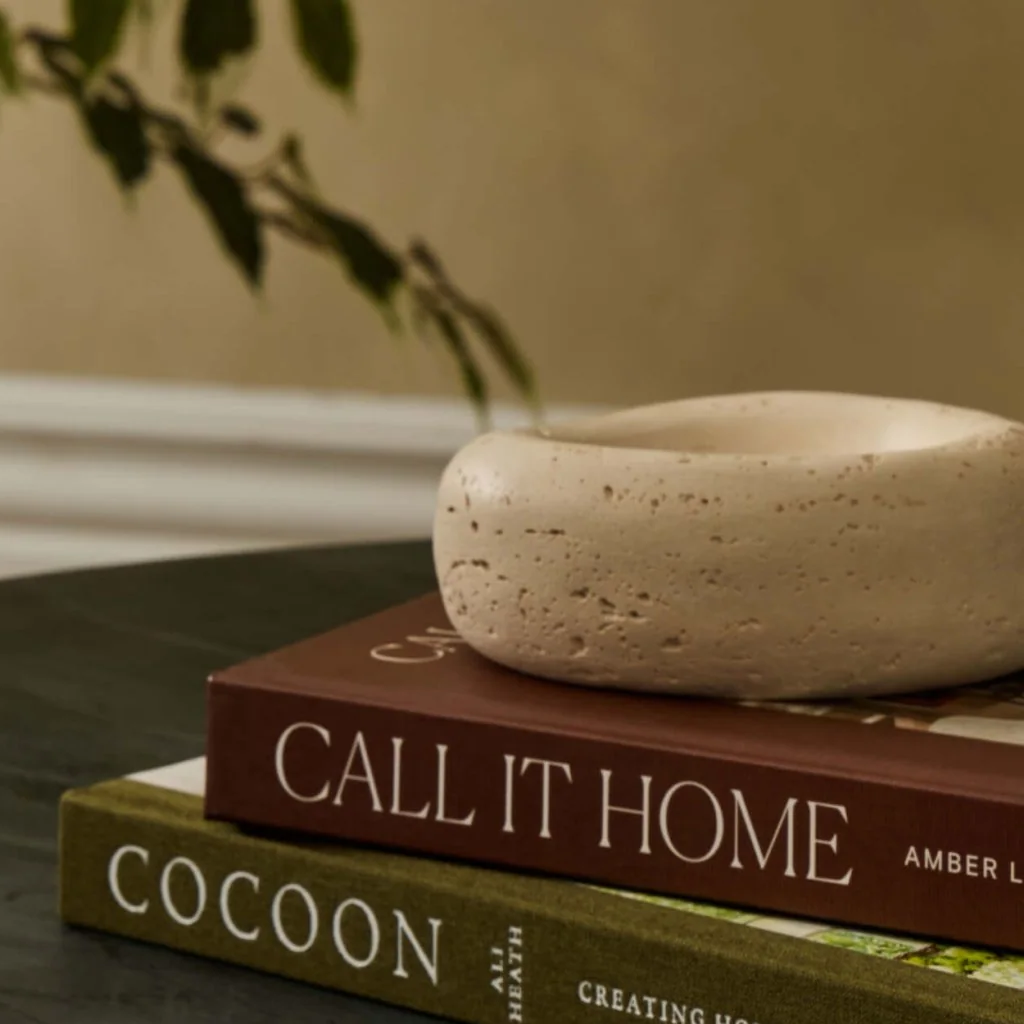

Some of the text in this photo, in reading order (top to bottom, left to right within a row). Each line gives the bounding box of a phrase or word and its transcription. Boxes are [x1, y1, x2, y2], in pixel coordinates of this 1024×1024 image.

[274, 721, 854, 887] CALL IT HOME
[903, 845, 998, 880] AMBER
[107, 843, 443, 986] COCOON
[490, 947, 505, 993] ALI
[507, 925, 524, 1023] HEATH
